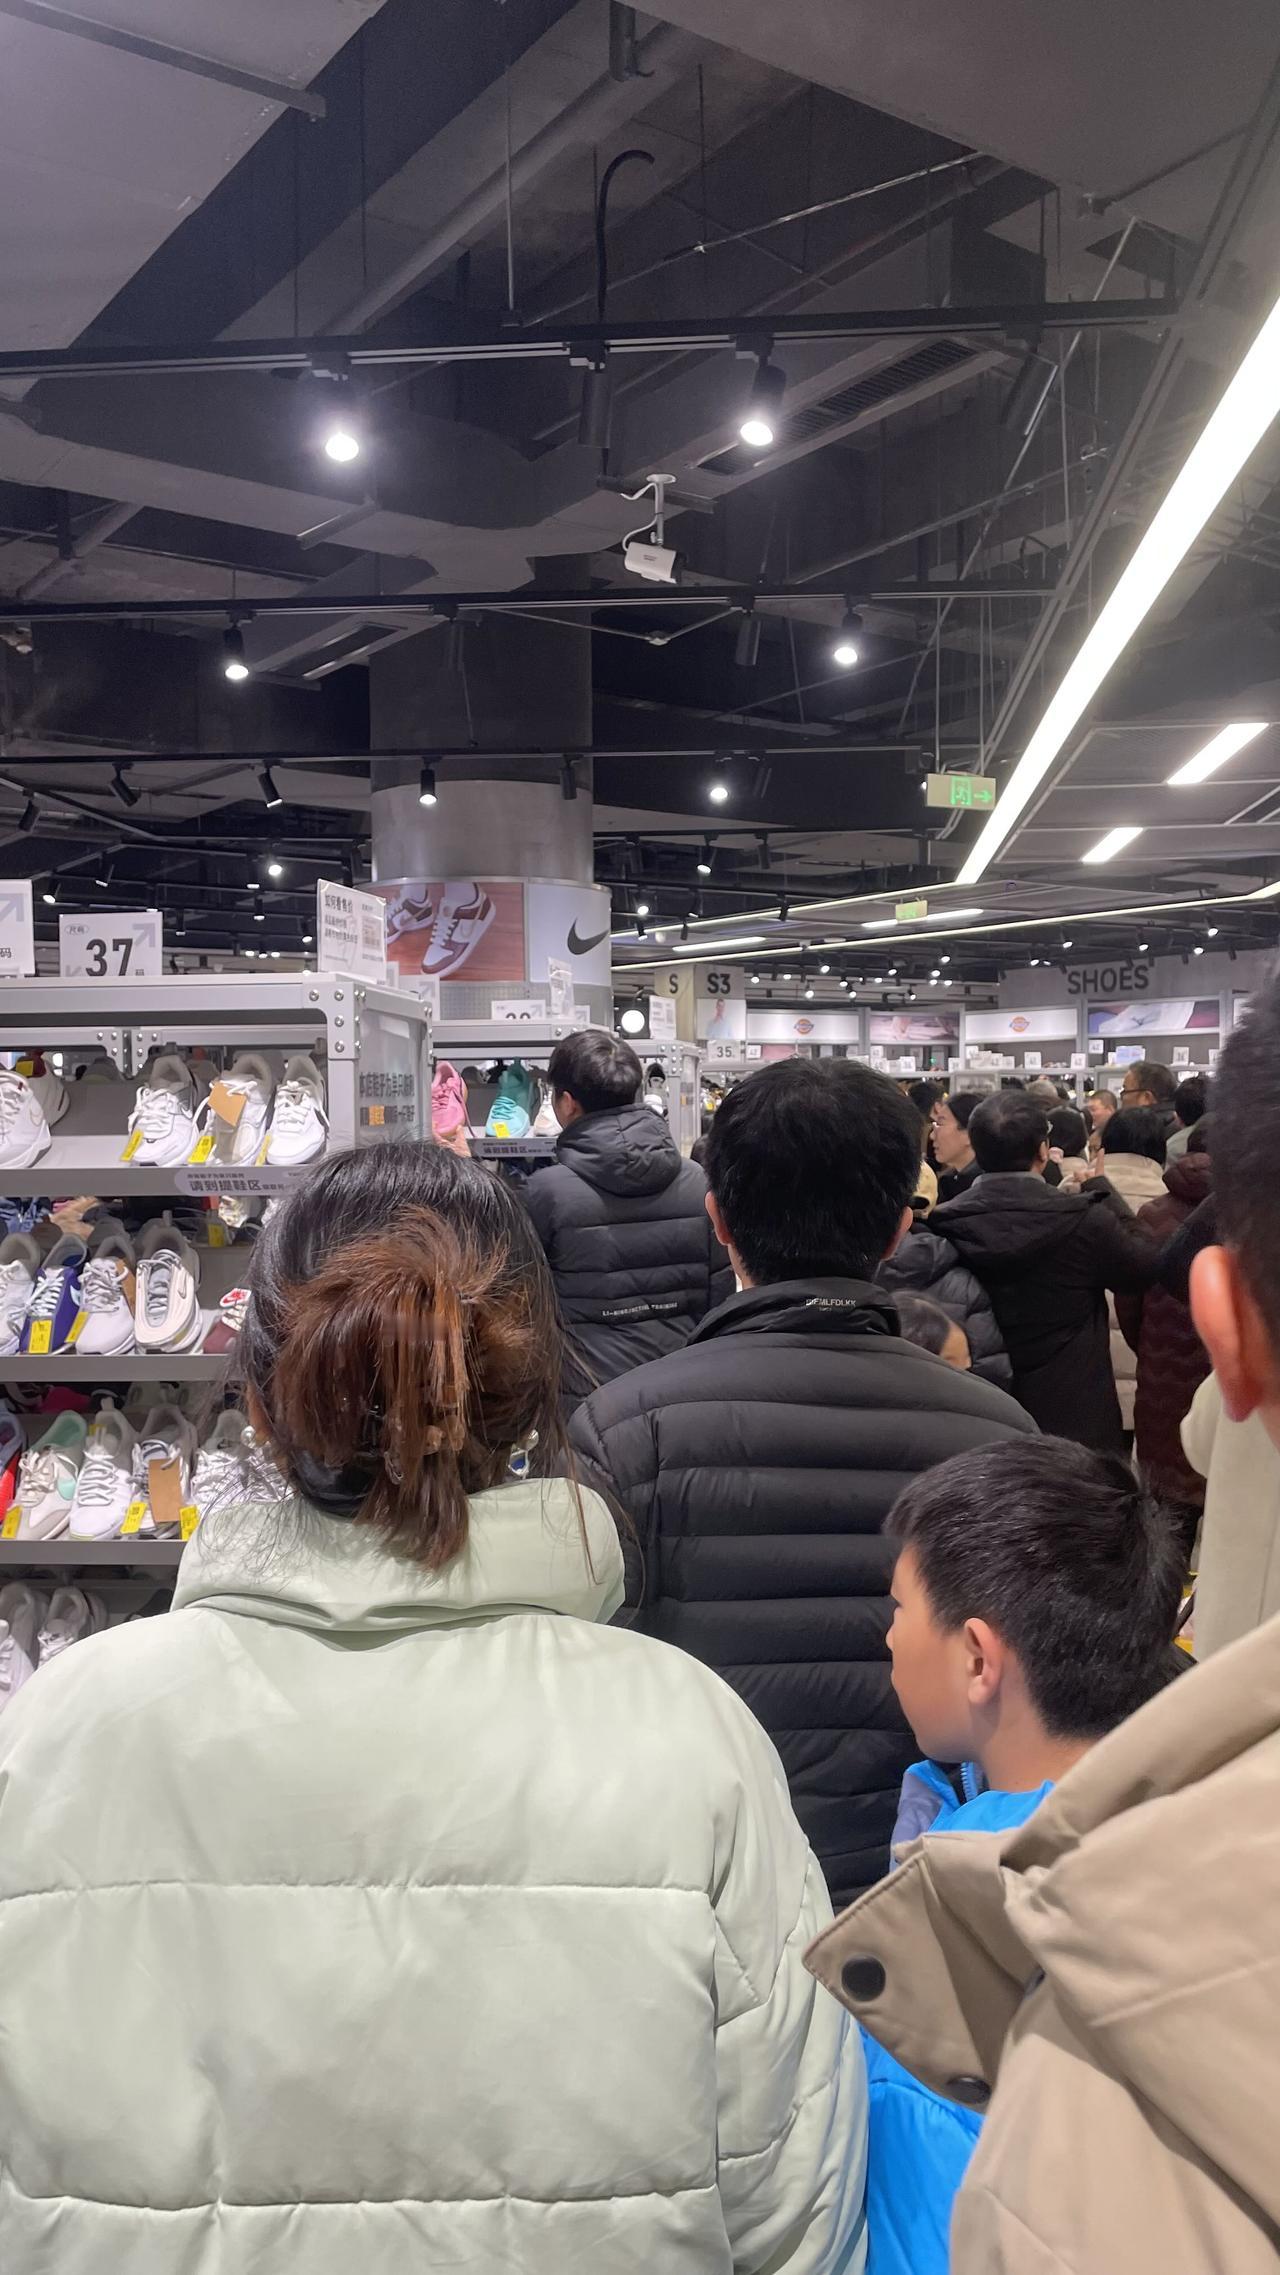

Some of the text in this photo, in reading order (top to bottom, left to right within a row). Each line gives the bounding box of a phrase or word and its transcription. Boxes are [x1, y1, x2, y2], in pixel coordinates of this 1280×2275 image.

[85, 938, 134, 977] 37
[707, 973, 731, 994] S3
[1067, 965, 1149, 995] SHOES
[716, 1046, 732, 1058] 35
